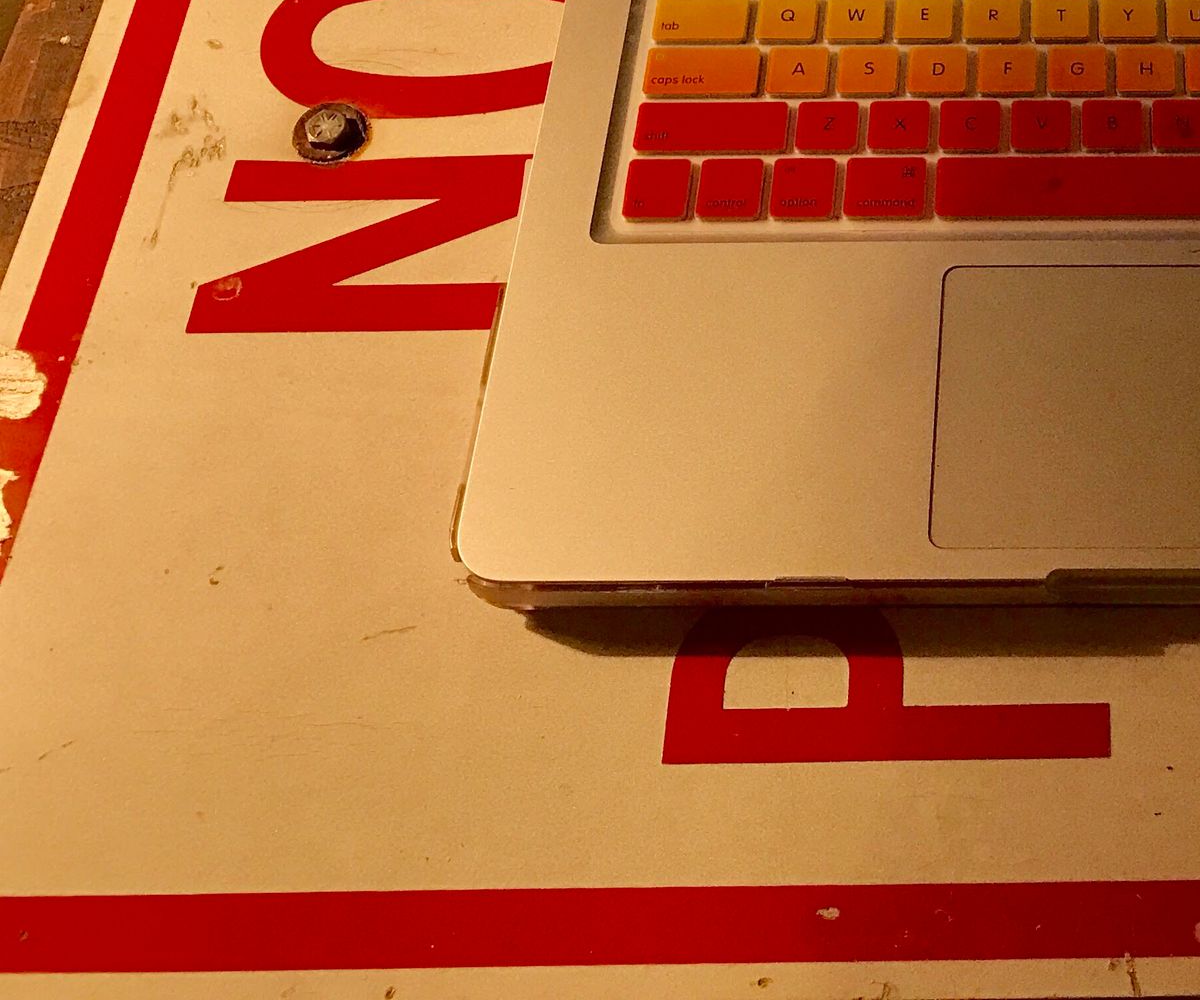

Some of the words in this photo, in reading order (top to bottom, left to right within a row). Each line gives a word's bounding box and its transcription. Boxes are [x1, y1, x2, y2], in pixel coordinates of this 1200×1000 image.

[780, 9, 795, 22] Q
[848, 9, 866, 22] W
[920, 9, 930, 22] E
[988, 9, 998, 22] R
[1056, 9, 1066, 22] T
[1122, 9, 1134, 22] Y
[660, 21, 680, 31] tab
[792, 62, 806, 76] A
[864, 62, 874, 76] S
[932, 62, 946, 76] D
[1004, 62, 1012, 76] F
[1070, 62, 1085, 76] G
[1140, 62, 1154, 76] H
[651, 75, 679, 86] caps
[682, 74, 704, 85] lock
